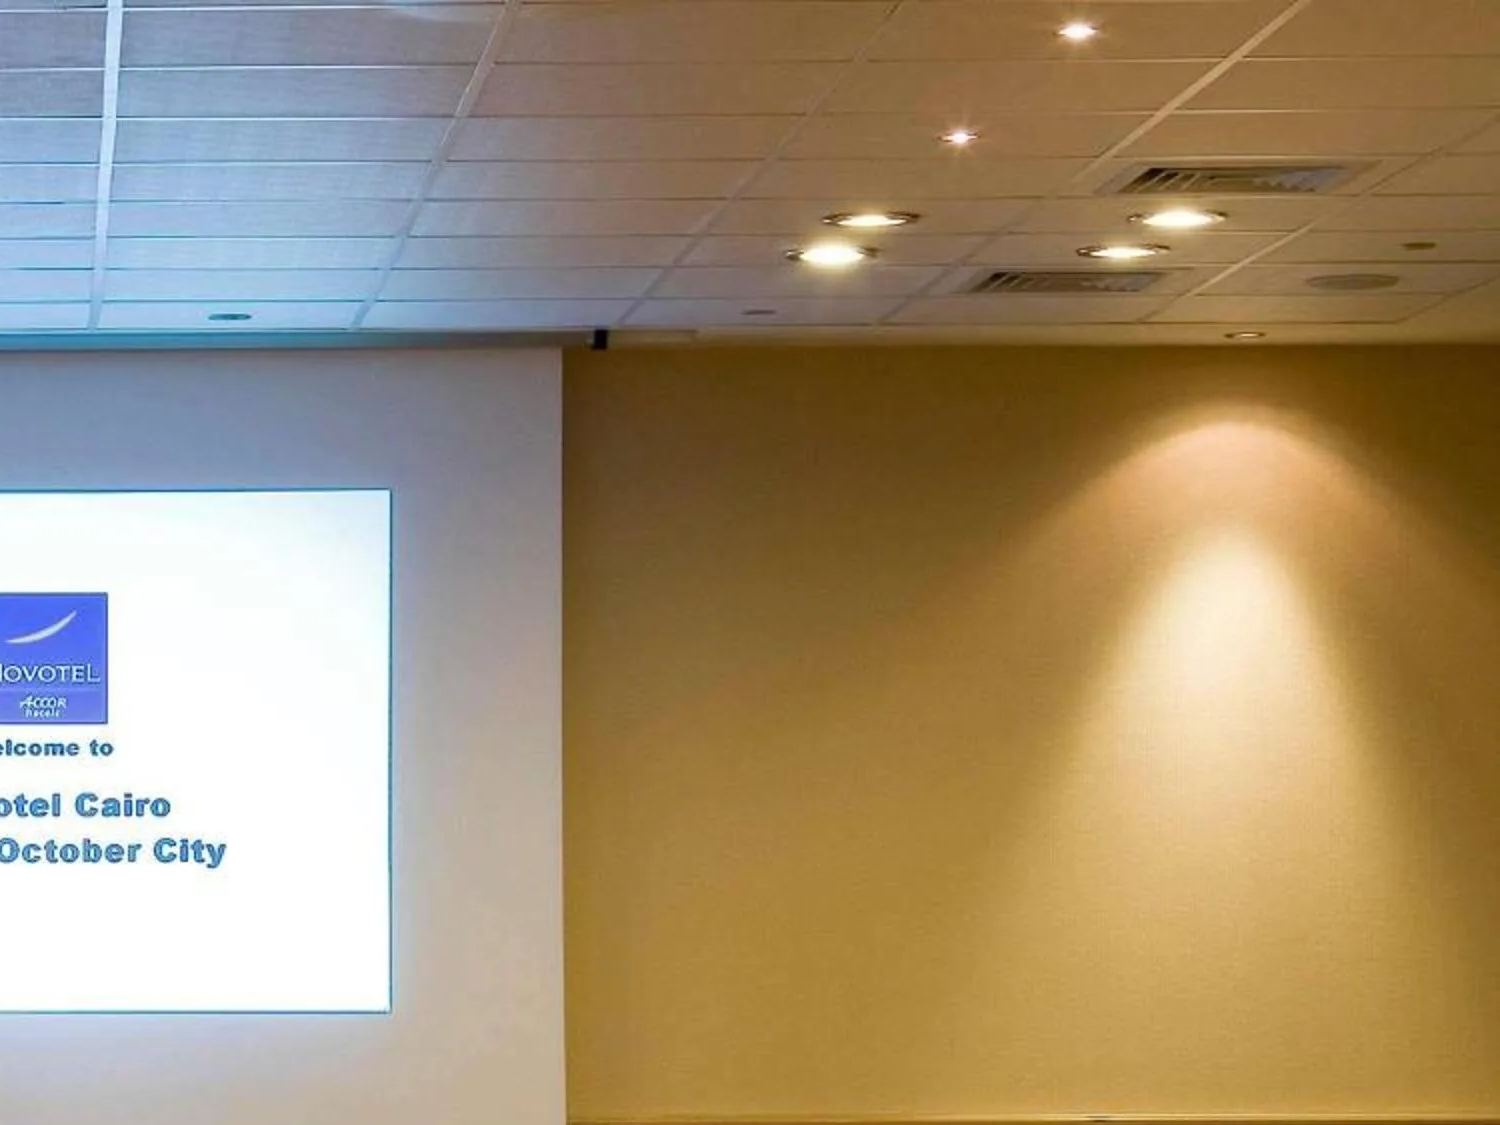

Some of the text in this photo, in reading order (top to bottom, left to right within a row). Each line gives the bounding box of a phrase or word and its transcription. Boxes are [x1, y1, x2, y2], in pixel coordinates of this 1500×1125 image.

[89, 739, 115, 757] to
[75, 793, 172, 818] Cairo
[153, 838, 228, 869] City
